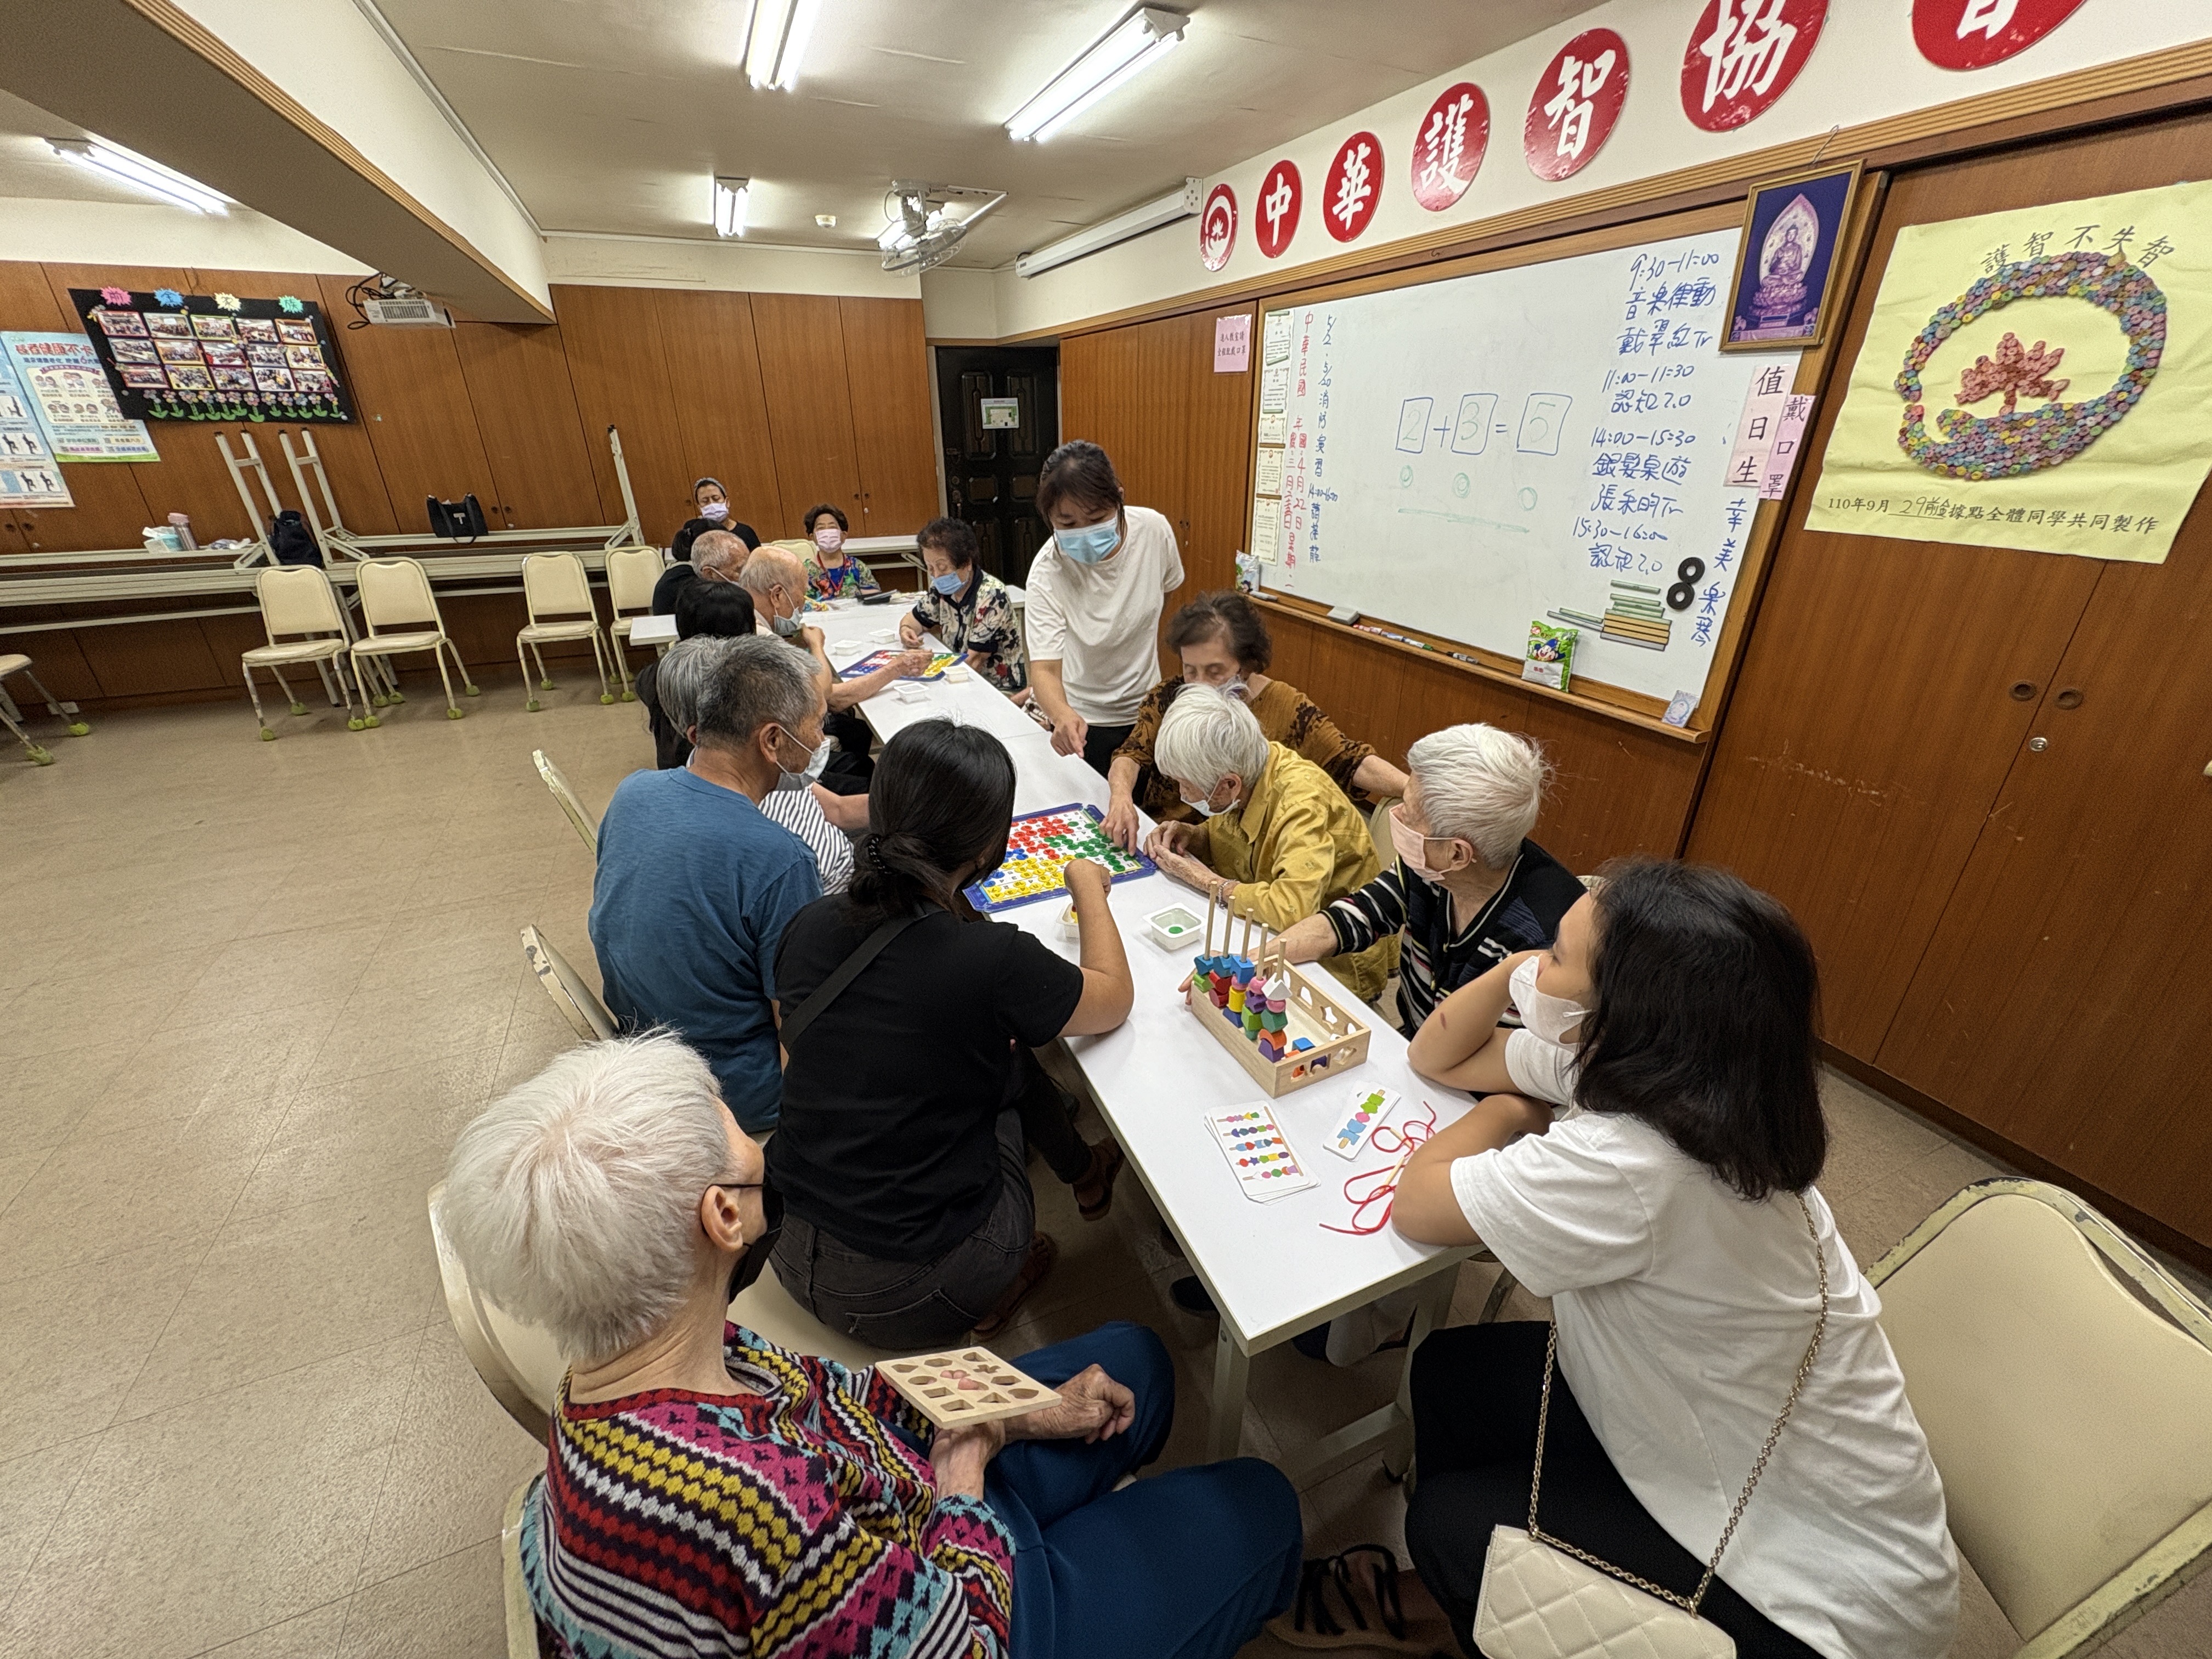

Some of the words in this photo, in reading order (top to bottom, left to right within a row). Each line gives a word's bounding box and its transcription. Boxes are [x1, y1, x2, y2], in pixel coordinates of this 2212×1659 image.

[1980, 225, 2174, 274] 護智不失智
[1732, 366, 1785, 483] 值日生
[1762, 396, 1810, 498] 戴口罩
